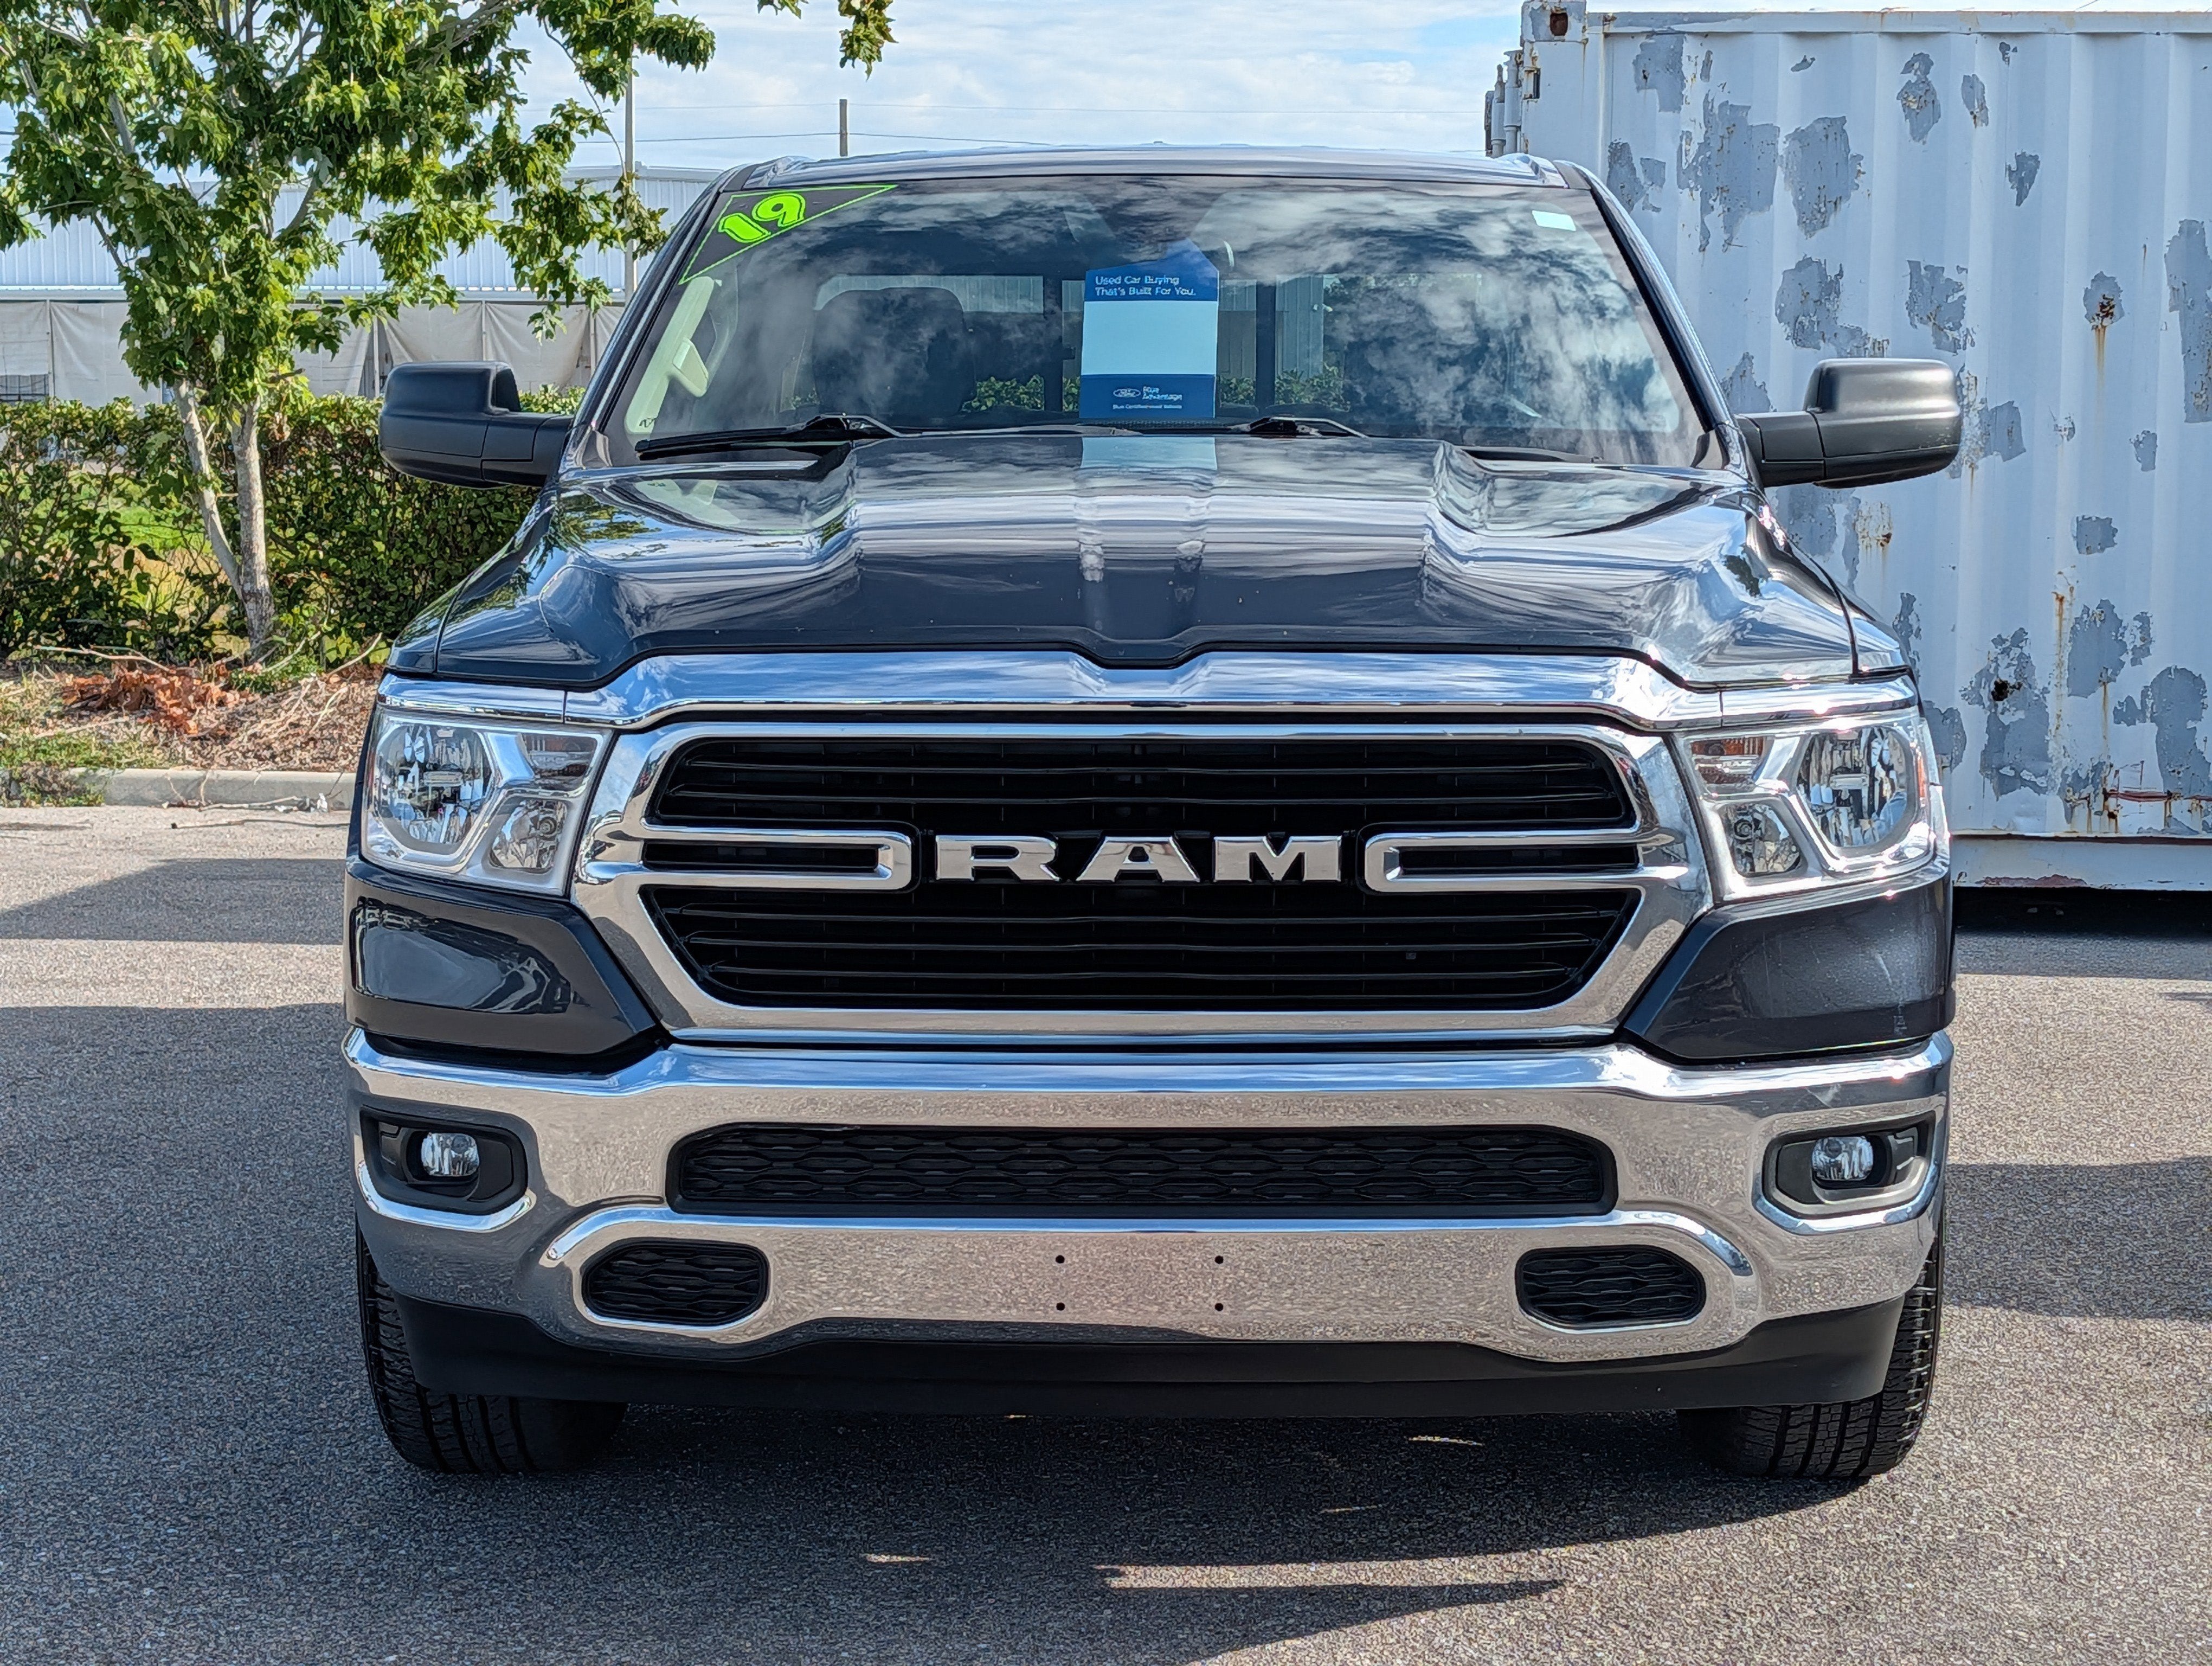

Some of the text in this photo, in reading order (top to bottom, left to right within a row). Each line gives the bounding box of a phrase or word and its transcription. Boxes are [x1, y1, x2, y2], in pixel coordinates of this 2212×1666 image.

[718, 193, 806, 243] 19
[1095, 275, 1180, 285] Used Car Buying
[1095, 287, 1196, 296] That's Built For You.
[935, 835, 1342, 882] RAM
